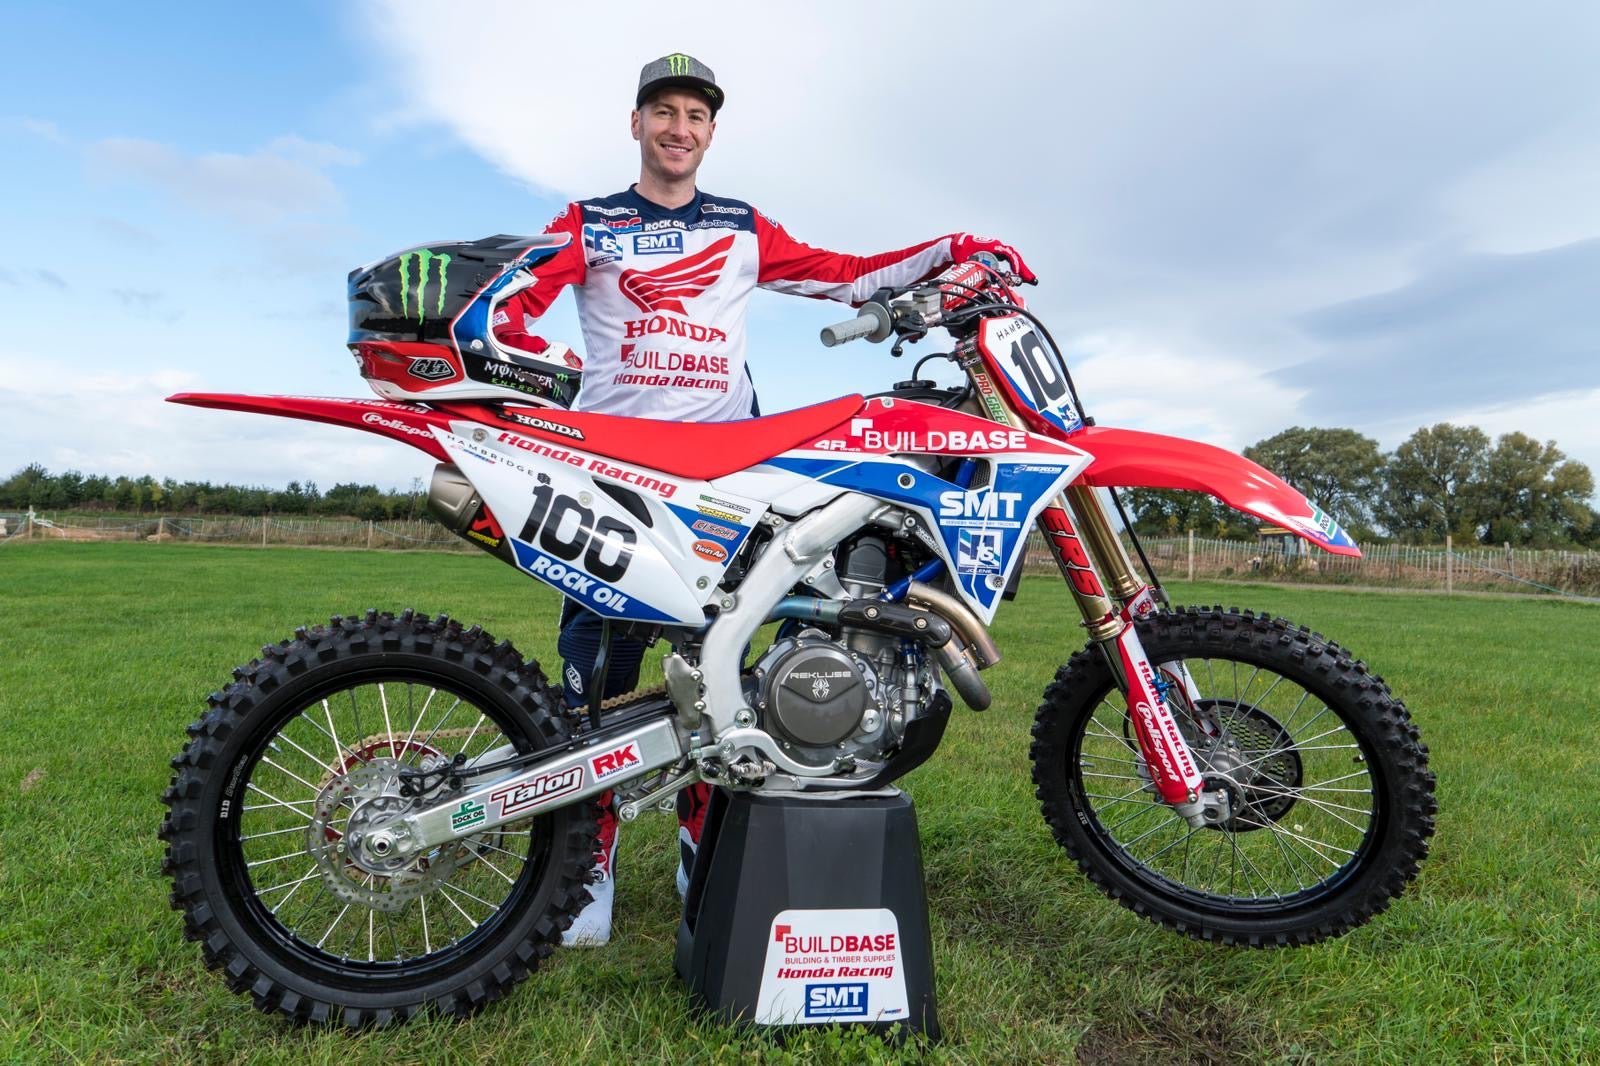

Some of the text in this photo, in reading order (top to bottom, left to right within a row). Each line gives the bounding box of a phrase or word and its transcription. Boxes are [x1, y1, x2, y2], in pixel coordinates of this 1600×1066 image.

[644, 220, 671, 231] ROCK
[672, 220, 687, 230] OIL
[636, 233, 679, 249] SMT
[624, 316, 727, 343] HONDA
[625, 351, 729, 375] BUILDBASE
[613, 373, 729, 393] Honda Racing
[516, 413, 584, 439] HONDA
[865, 431, 1027, 451] BUILDBASE
[497, 433, 585, 466] Honda
[588, 459, 678, 499] Racing
[939, 491, 1022, 518] SMT
[518, 485, 638, 583] 100
[530, 555, 633, 613] ROCK OIL
[789, 671, 852, 679] REKLUSE
[1136, 701, 1180, 782] Polisport
[1164, 719, 1195, 778] Racing
[592, 744, 637, 775] RK
[494, 767, 583, 813] Talon
[452, 815, 472, 824] ROCK
[785, 934, 895, 953] BUILDBASE
[785, 957, 822, 965] BUILDING
[863, 954, 896, 962] SUPPLIES
[777, 966, 894, 979] Honda Racing
[809, 986, 864, 1007] SMT
